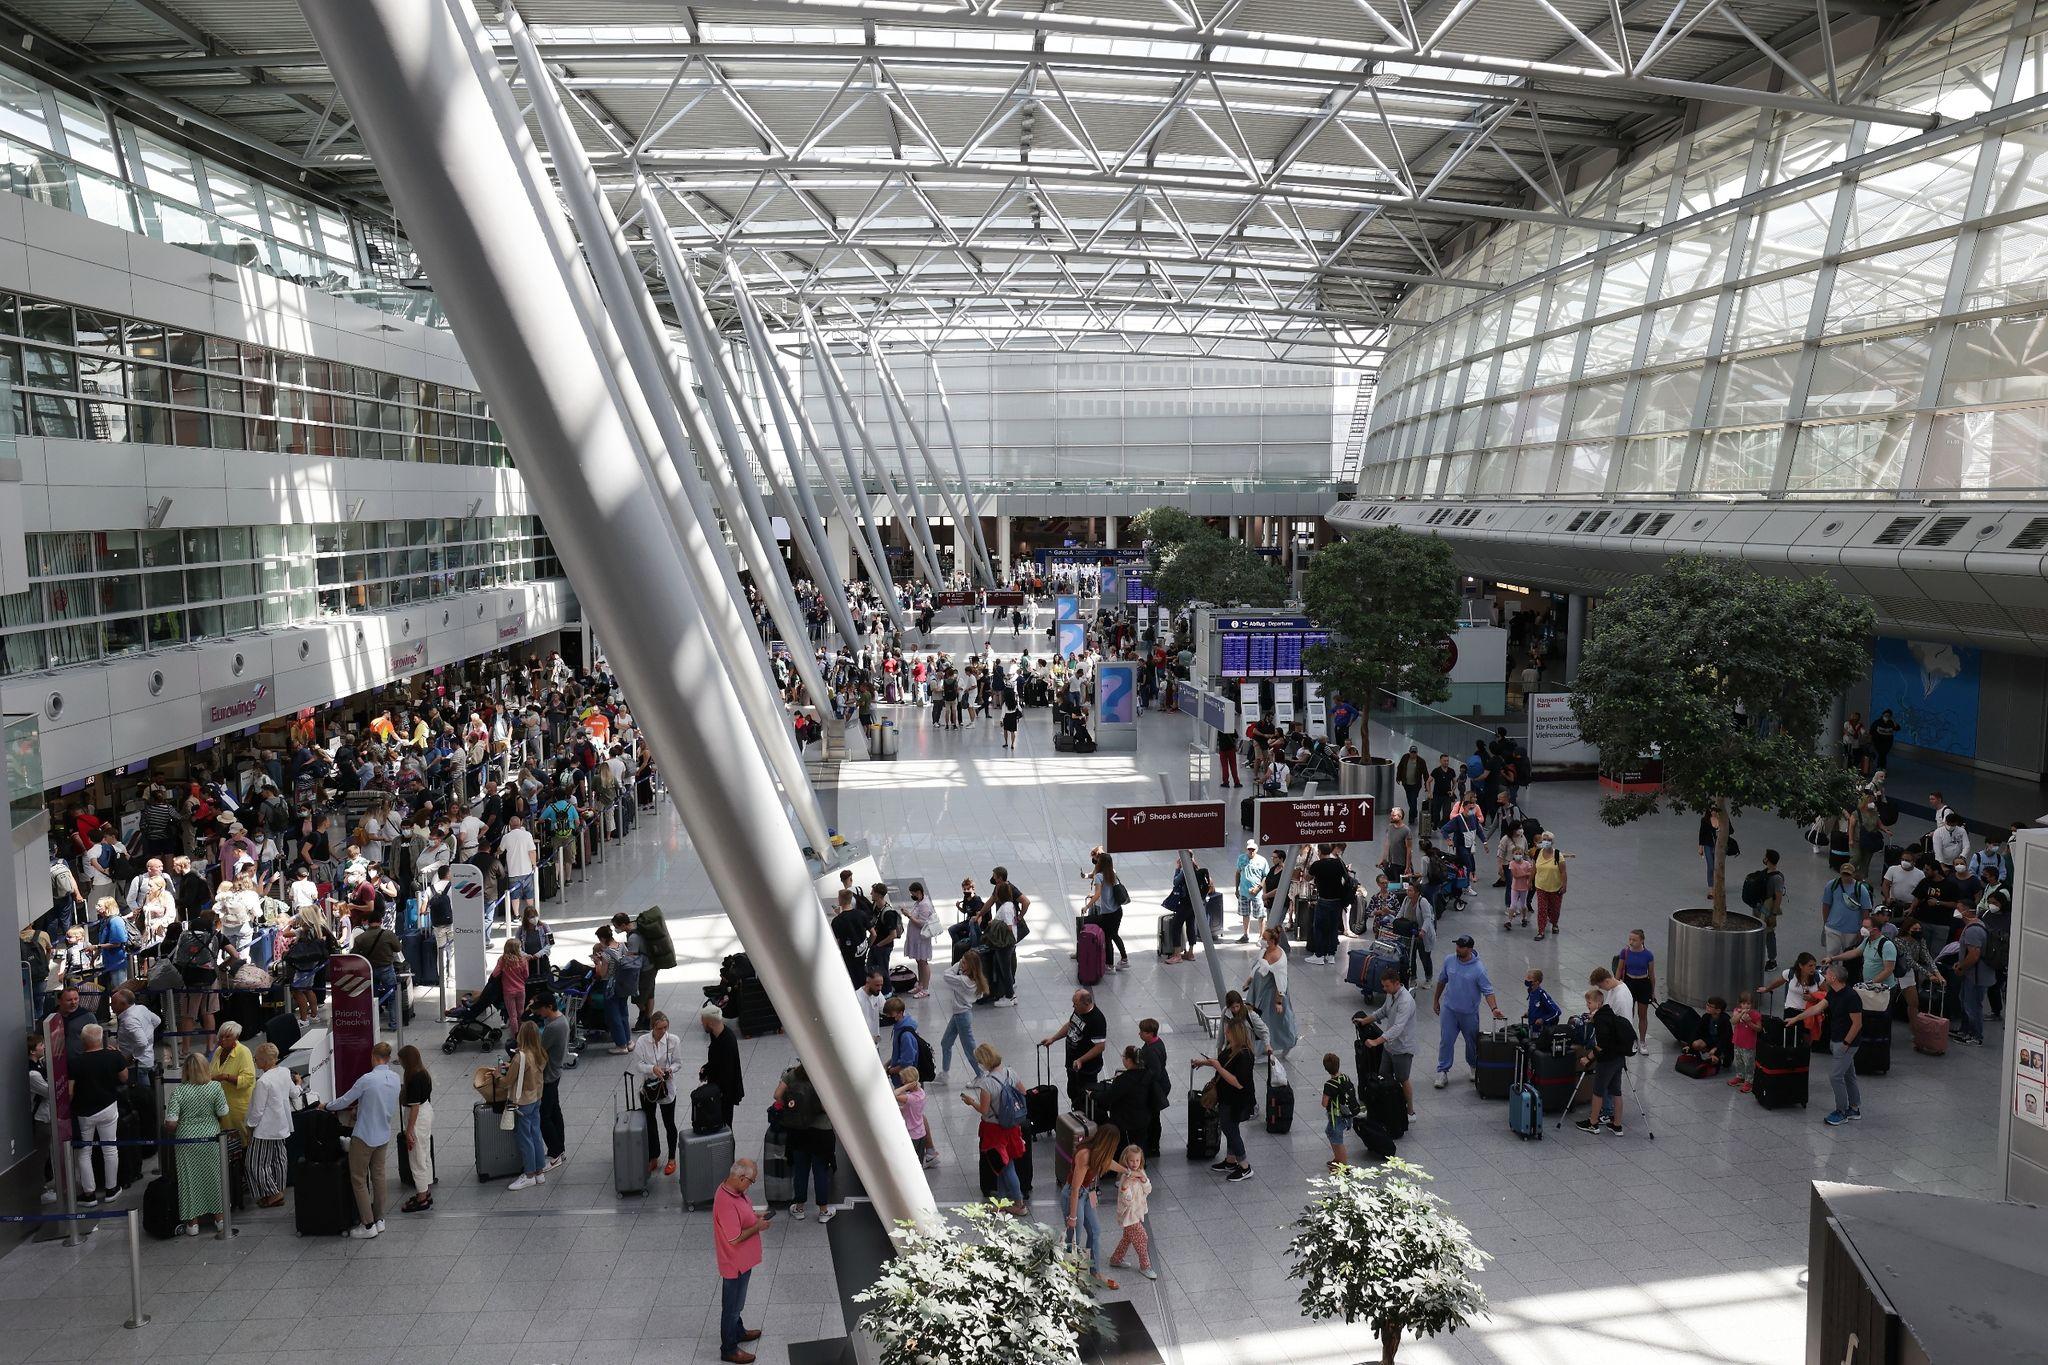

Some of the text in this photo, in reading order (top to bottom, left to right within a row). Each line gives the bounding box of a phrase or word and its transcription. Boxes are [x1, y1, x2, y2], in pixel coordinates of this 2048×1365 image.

[211, 698, 257, 722] Eurowings
[1149, 812, 1171, 821] Shops
[1179, 810, 1218, 819] Restaurants
[1296, 820, 1334, 828] Wickelraum
[1300, 828, 1317, 836] Baby
[335, 1010, 366, 1019] Priority-
[335, 1018, 371, 1026] Check-in
